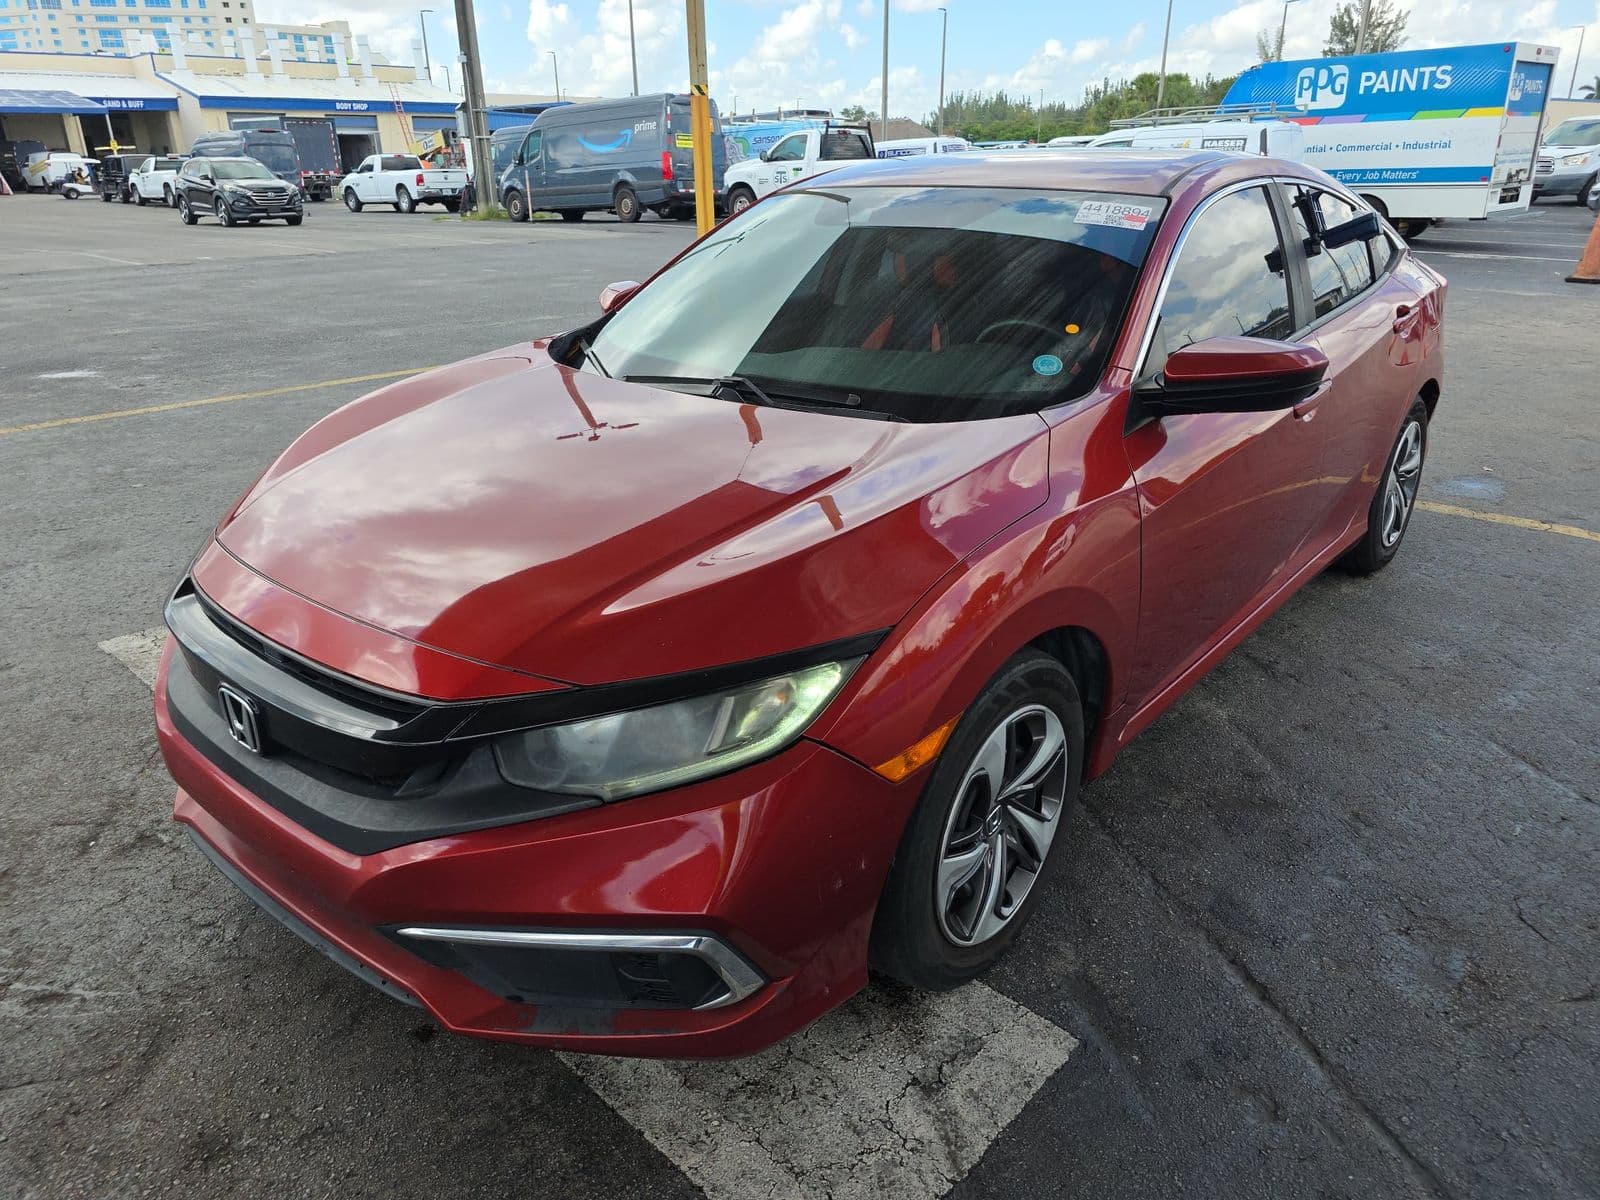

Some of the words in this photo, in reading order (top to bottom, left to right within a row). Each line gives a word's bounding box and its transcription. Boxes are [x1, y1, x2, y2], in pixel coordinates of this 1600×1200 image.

[1298, 68, 1347, 102] PPG
[1359, 65, 1452, 95] PAINTS
[102, 100, 120, 108] SAND
[121, 100, 127, 108] &
[128, 100, 144, 108] BUFF
[336, 102, 351, 110] BODY
[352, 103, 368, 111] SHOP
[634, 120, 657, 134] prime
[1336, 142, 1392, 152] Commercial
[1402, 140, 1451, 150] Industrial
[774, 171, 788, 184] STS
[1336, 171, 1361, 182] Every
[1363, 171, 1380, 180] Job
[1381, 170, 1417, 179] Matters
[1083, 203, 1151, 217] 4418894
